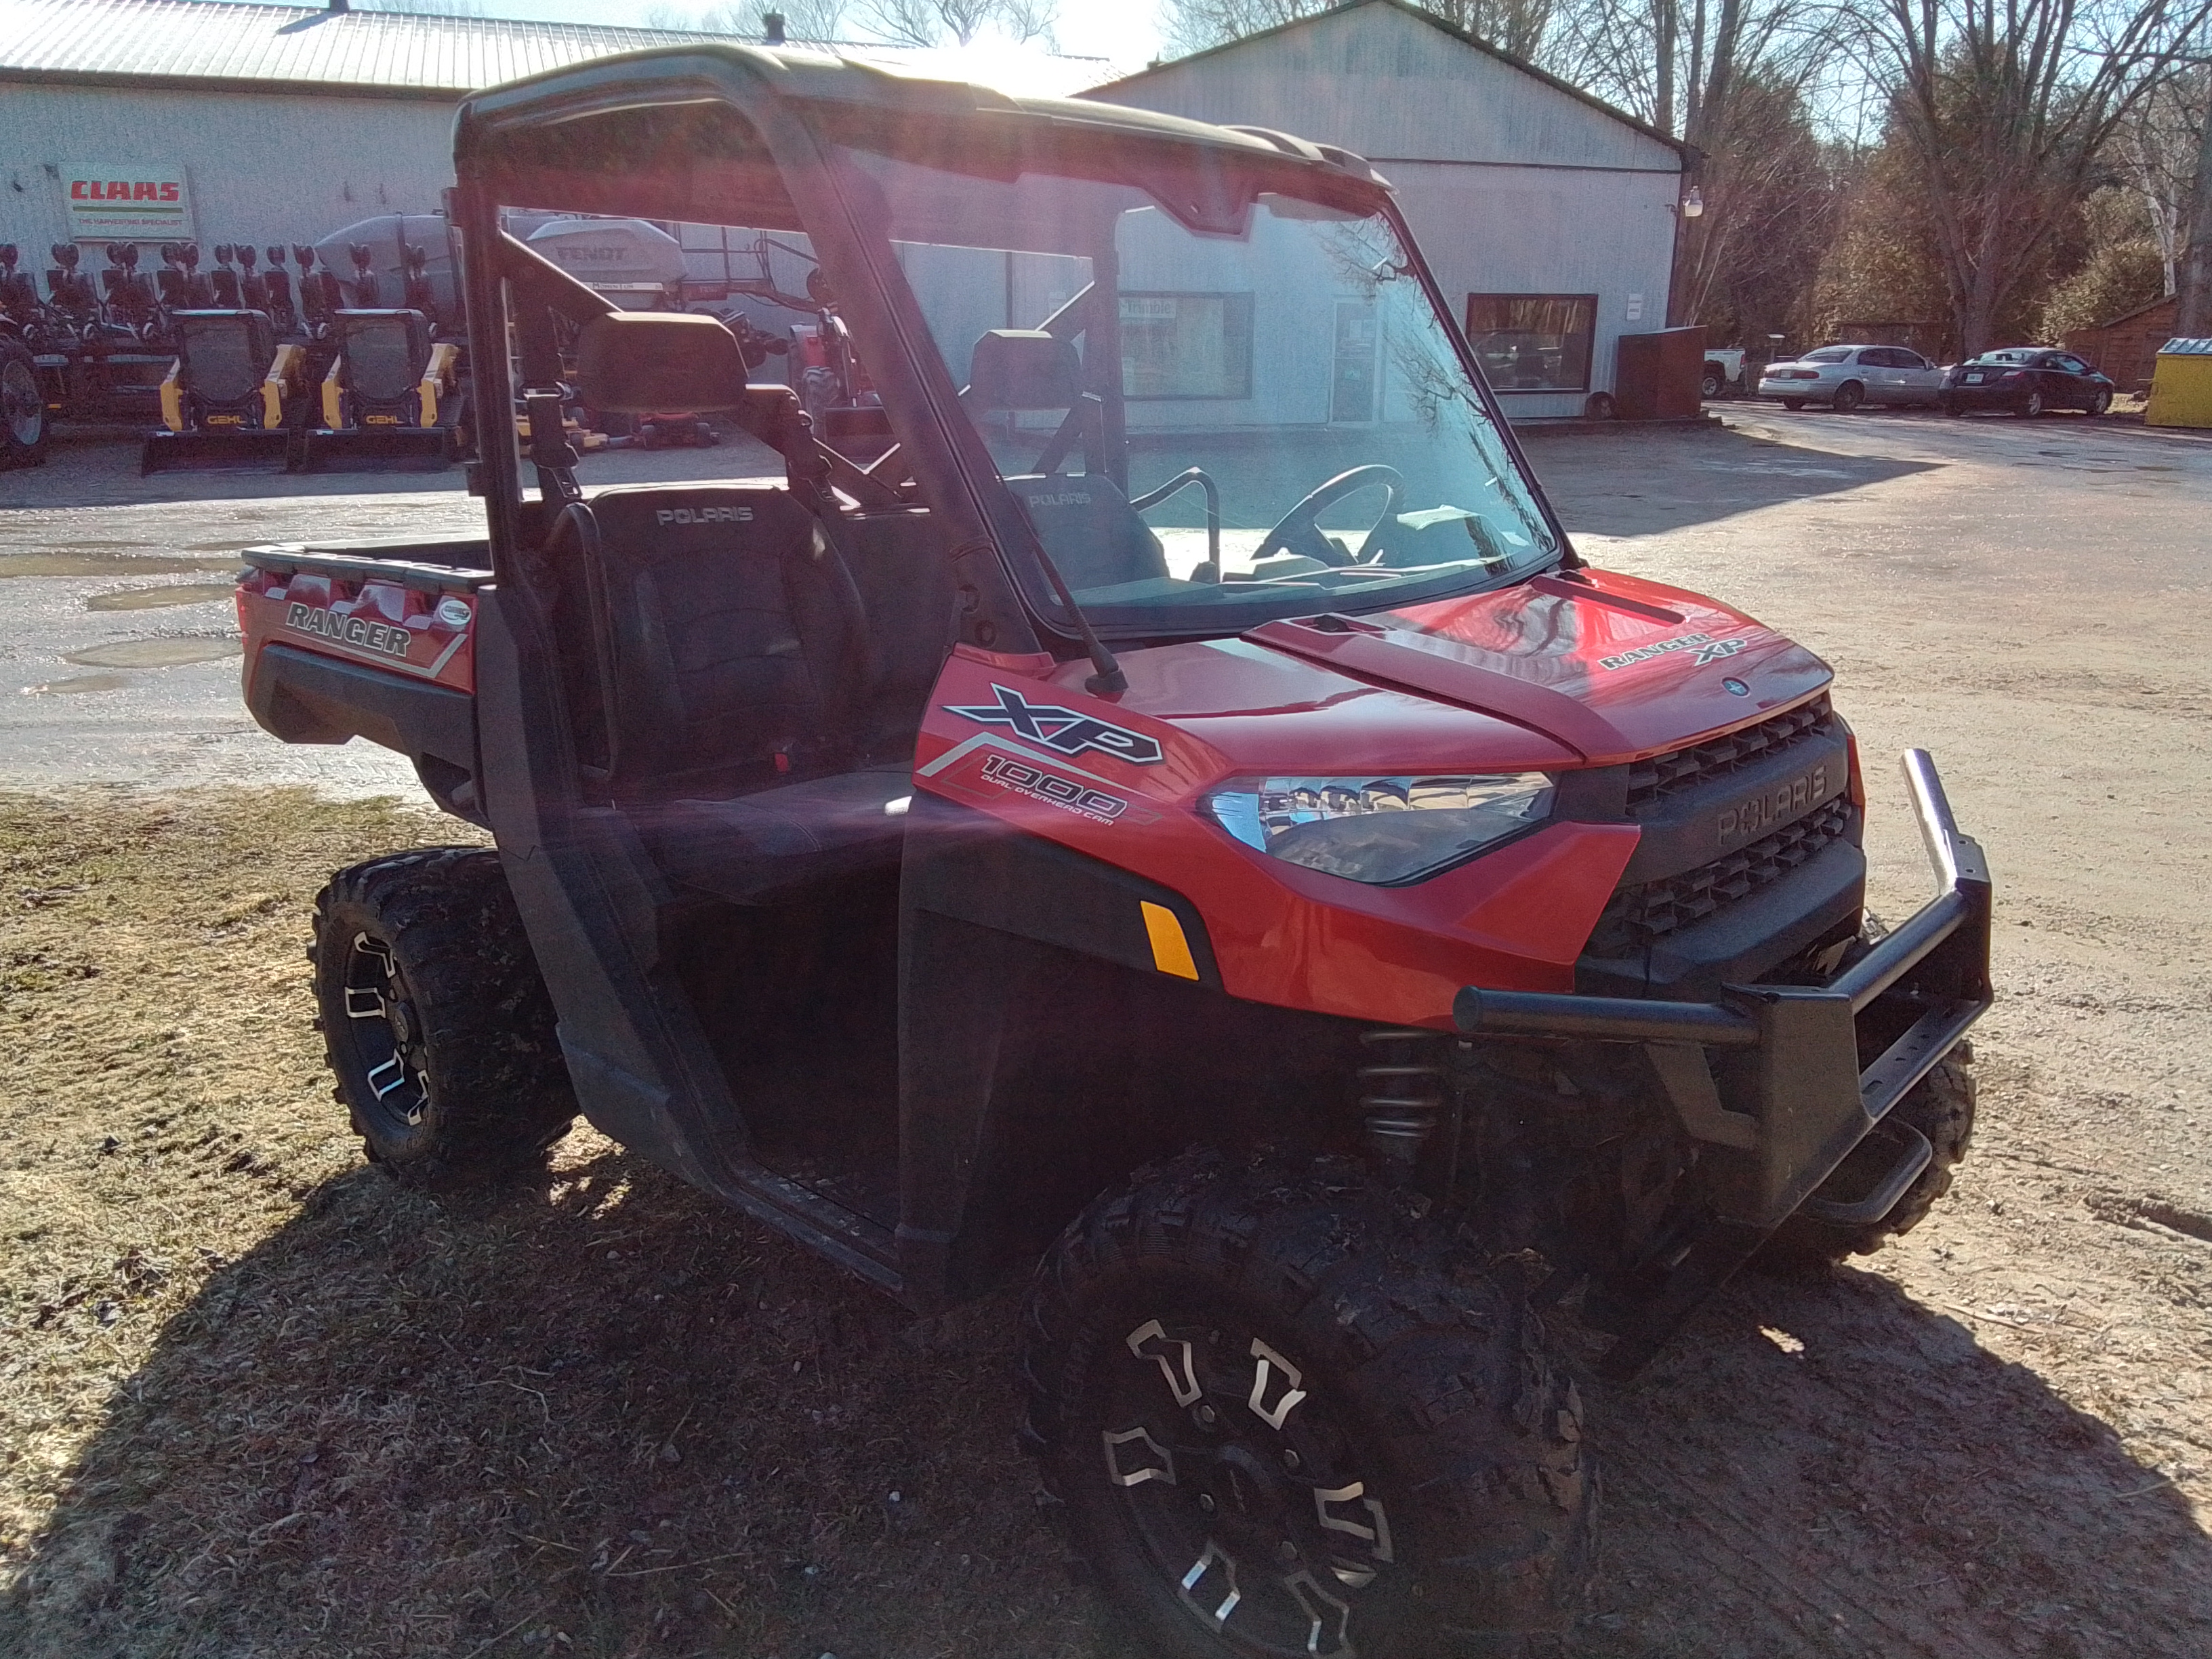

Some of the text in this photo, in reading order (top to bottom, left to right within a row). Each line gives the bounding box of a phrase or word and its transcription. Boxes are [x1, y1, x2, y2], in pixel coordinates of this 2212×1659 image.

[71, 180, 179, 201] CLAAS
[556, 247, 628, 260] FENDT
[207, 415, 247, 424] GEHL
[366, 415, 404, 424] GEHL
[1029, 493, 1090, 508] POLARIS
[657, 506, 754, 525] POLARIS
[285, 601, 411, 657] RANGER
[1597, 632, 1716, 670] RANGER
[1684, 638, 1748, 667] XP
[941, 682, 1164, 763] XP
[980, 775, 1114, 827] DUAL OVERHEAD CAM
[981, 754, 1128, 819] 1000
[1716, 764, 1828, 846] POLARIS
